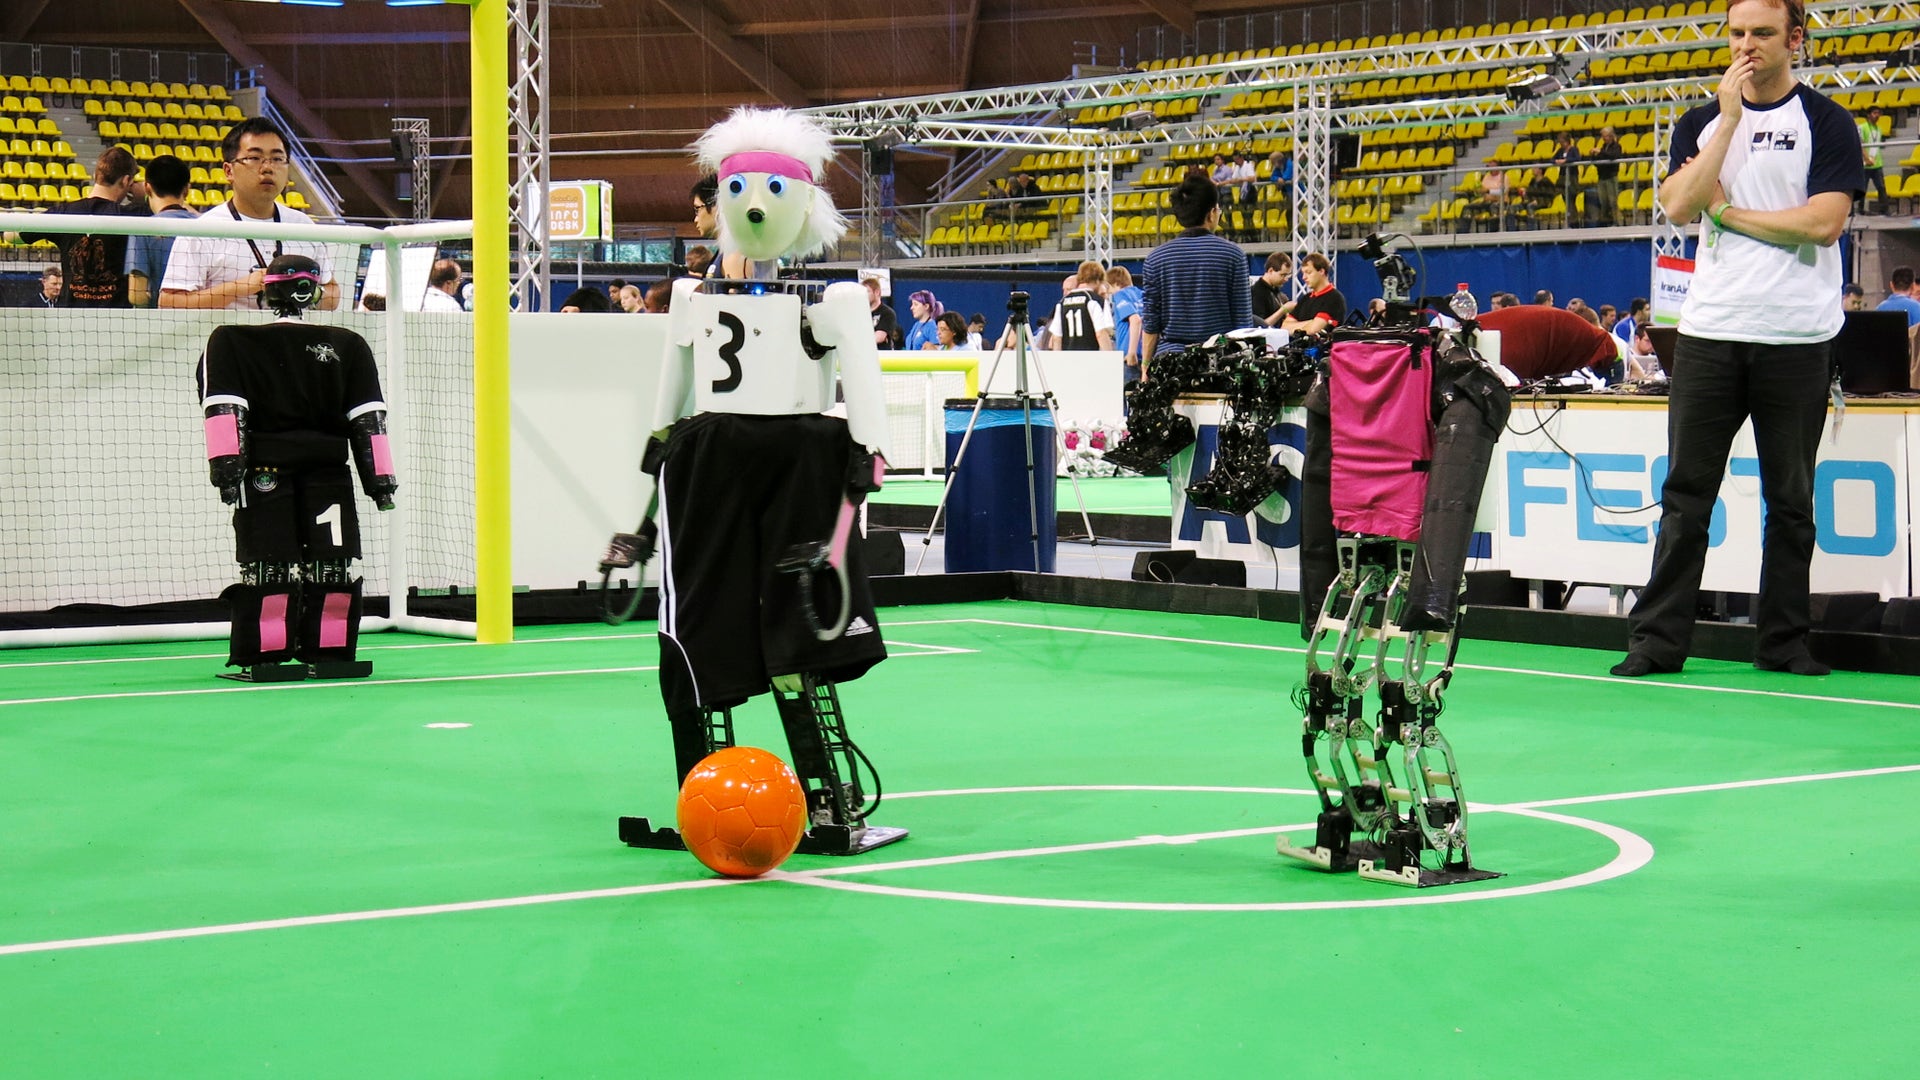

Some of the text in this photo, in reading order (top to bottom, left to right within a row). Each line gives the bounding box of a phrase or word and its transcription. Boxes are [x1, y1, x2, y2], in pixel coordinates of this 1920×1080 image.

[550, 210, 579, 220] INFO
[550, 221, 579, 230] DESK
[1065, 308, 1083, 337] 11
[712, 311, 746, 393] 3
[316, 503, 343, 547] 1
